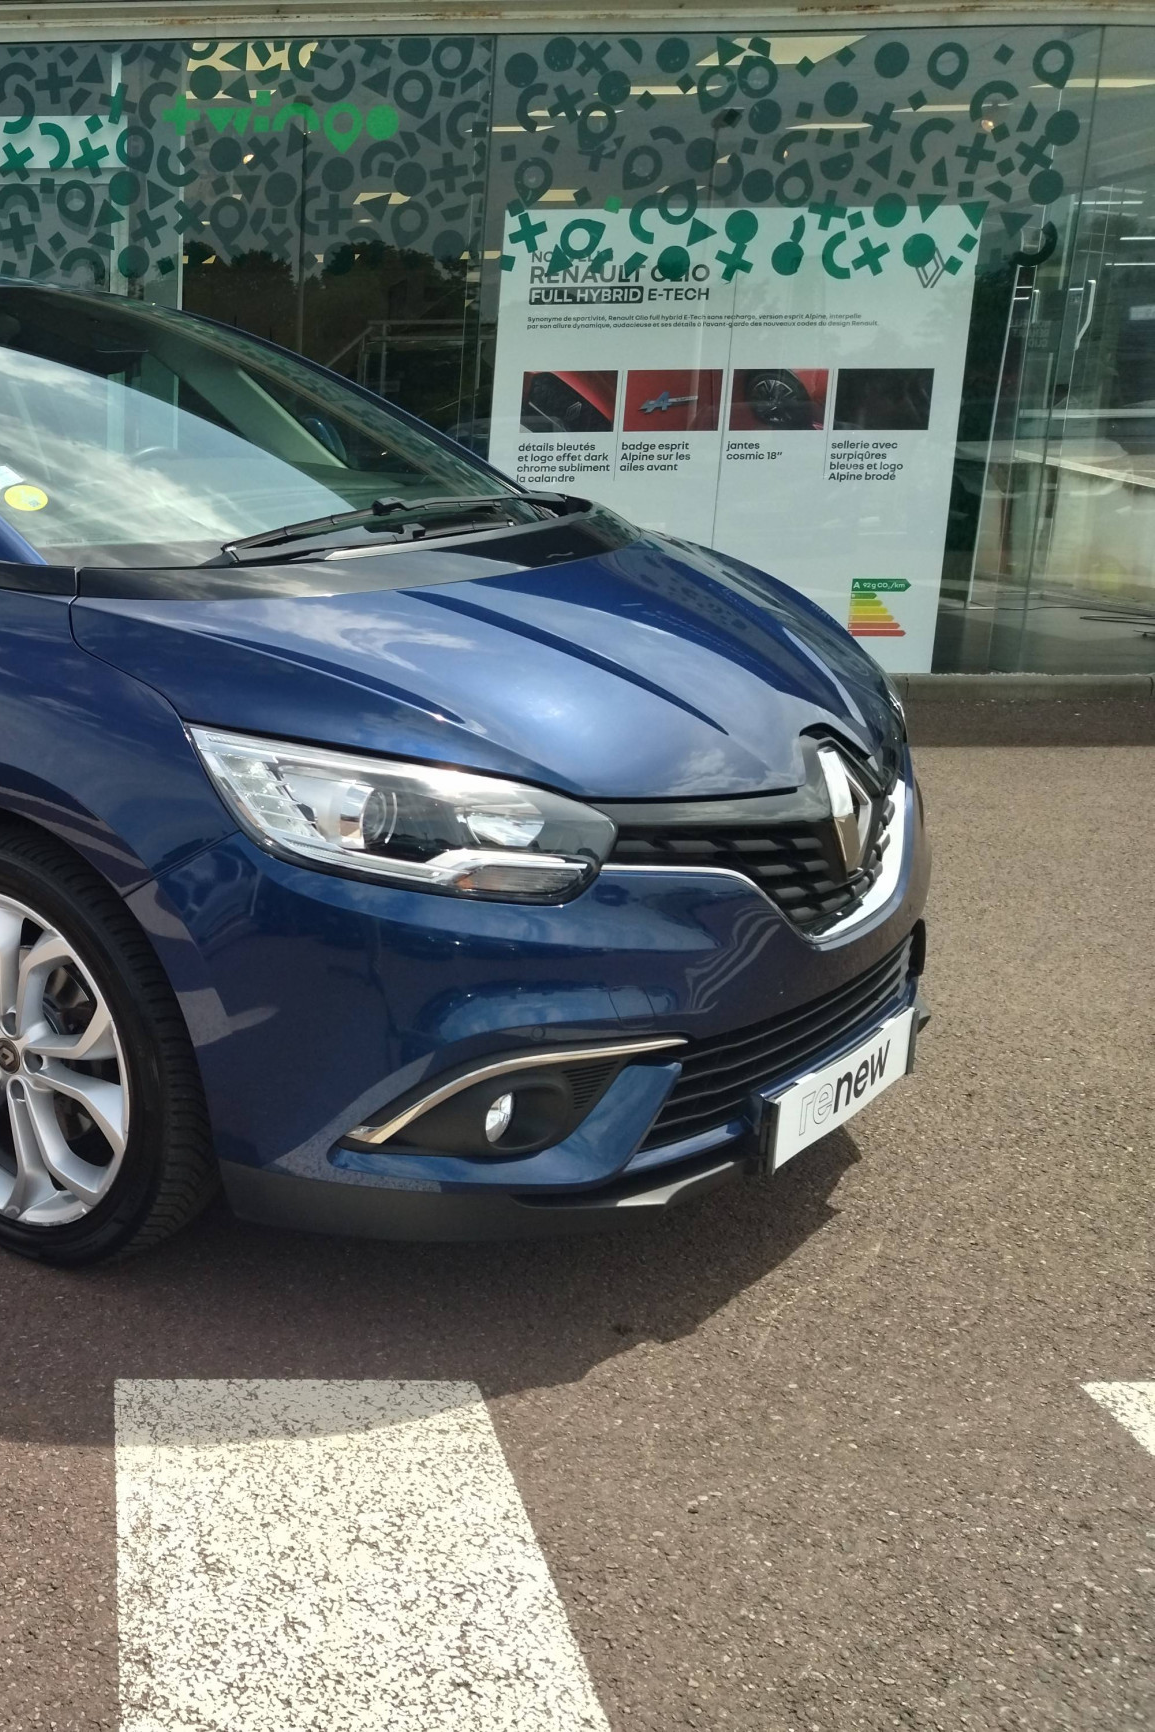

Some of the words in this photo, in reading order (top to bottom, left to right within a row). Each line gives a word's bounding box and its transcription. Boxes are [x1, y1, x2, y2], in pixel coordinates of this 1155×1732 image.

[531, 289, 574, 303] FULL
[576, 288, 642, 302] HYBRID
[647, 287, 710, 301] E-TECH
[661, 314, 683, 322] hybrid
[784, 313, 804, 321] esprit
[829, 313, 862, 321] interpelle
[572, 322, 612, 330] dynamique,
[827, 320, 850, 328] design
[518, 442, 554, 452] détails
[556, 442, 596, 451] bleutés
[621, 441, 656, 453] badge
[657, 441, 690, 452] esprit
[726, 440, 760, 452] jantes
[831, 440, 870, 450] sellerie
[871, 442, 898, 450] avec
[517, 453, 528, 462] et
[530, 452, 554, 464] logo
[555, 452, 582, 462] effet
[583, 452, 609, 462] dark
[620, 452, 655, 463] Alpine
[675, 451, 691, 461] les
[726, 451, 765, 460] cosmic
[830, 451, 887, 462] surpiqûres
[516, 464, 557, 473] chrome
[558, 463, 610, 472] subliment
[619, 462, 645, 472] ailes
[646, 463, 678, 471] avant
[829, 461, 865, 470] bleues
[866, 462, 878, 470] et
[879, 461, 904, 473] logo
[516, 474, 526, 483] la
[528, 474, 575, 483] calandre
[828, 471, 863, 482] Alpine
[864, 471, 896, 481] brodé
[853, 581, 861, 589] A
[798, 1039, 891, 1137] renew
